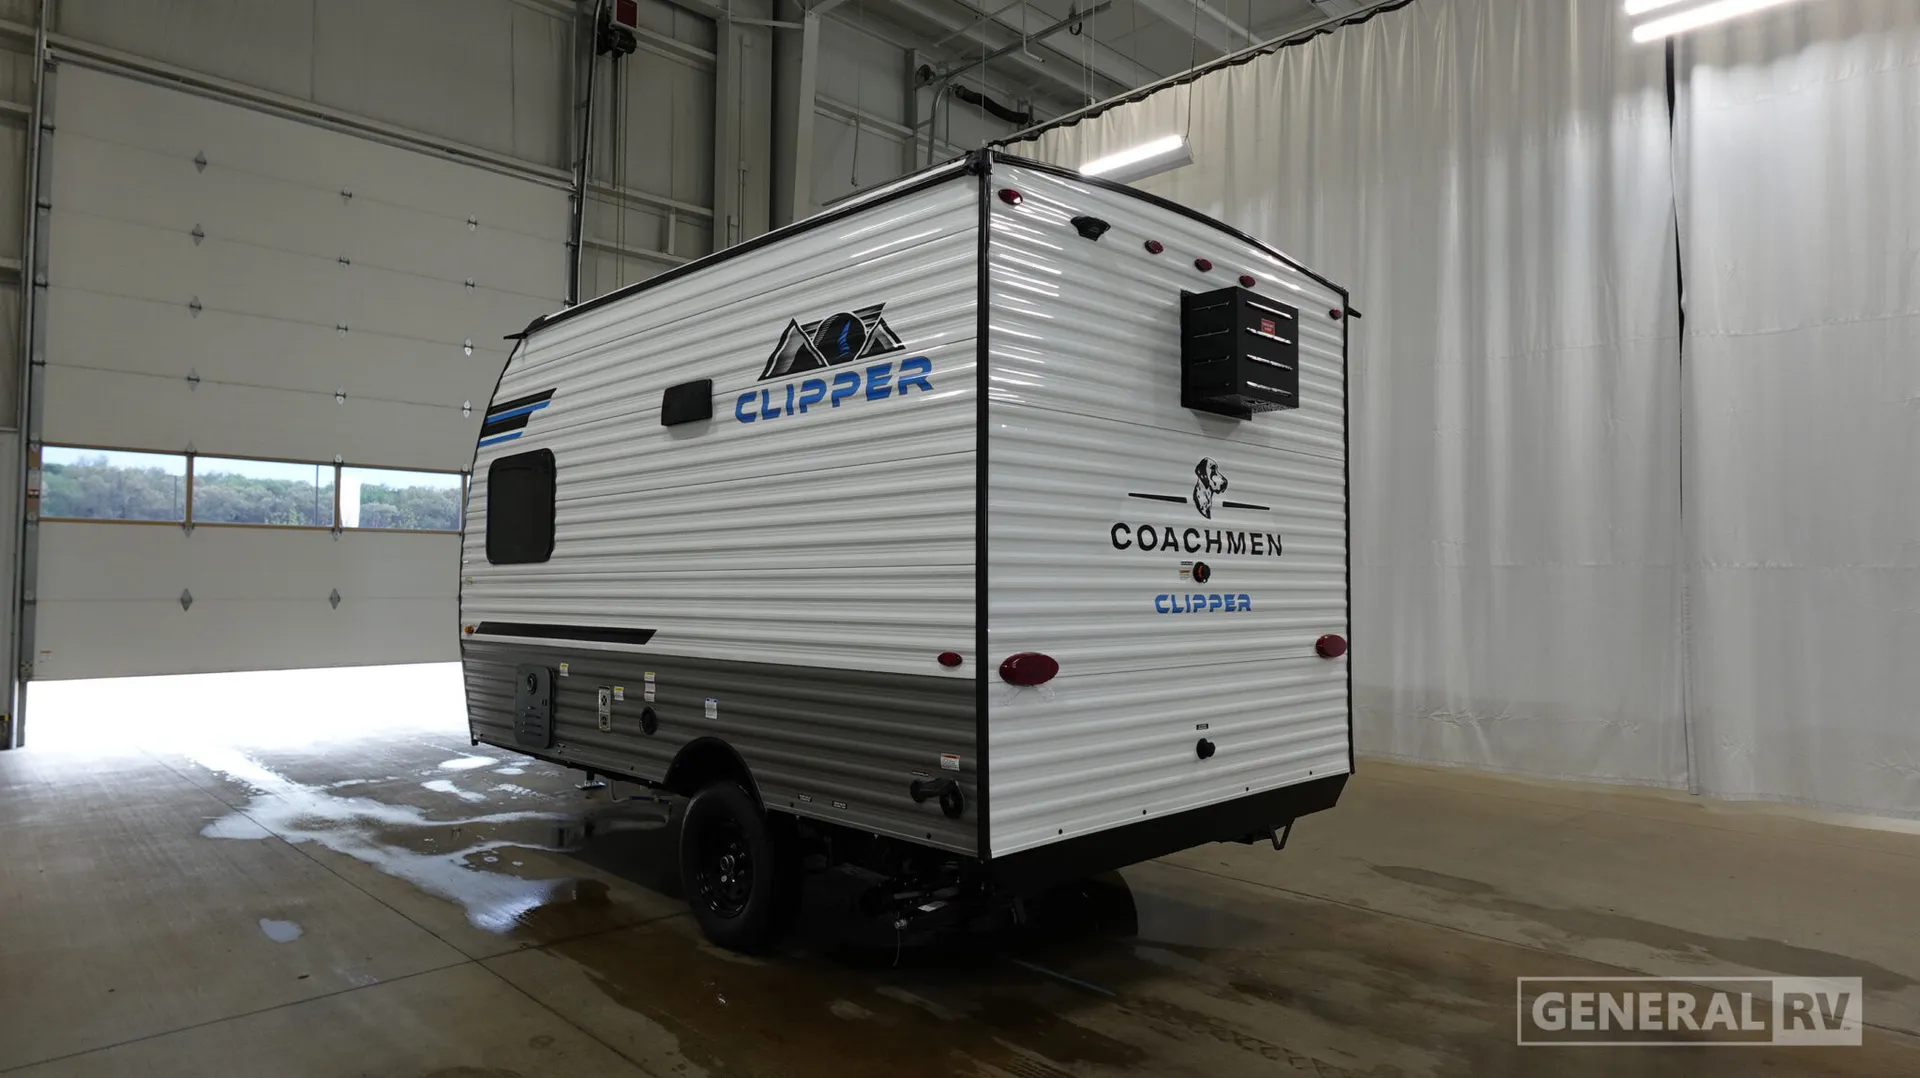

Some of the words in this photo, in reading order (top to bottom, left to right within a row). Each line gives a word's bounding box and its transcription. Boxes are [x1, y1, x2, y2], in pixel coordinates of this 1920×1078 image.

[735, 356, 934, 423] CLIPPER
[1111, 523, 1282, 556] COACHMEN
[1155, 594, 1251, 613] CLIPPER
